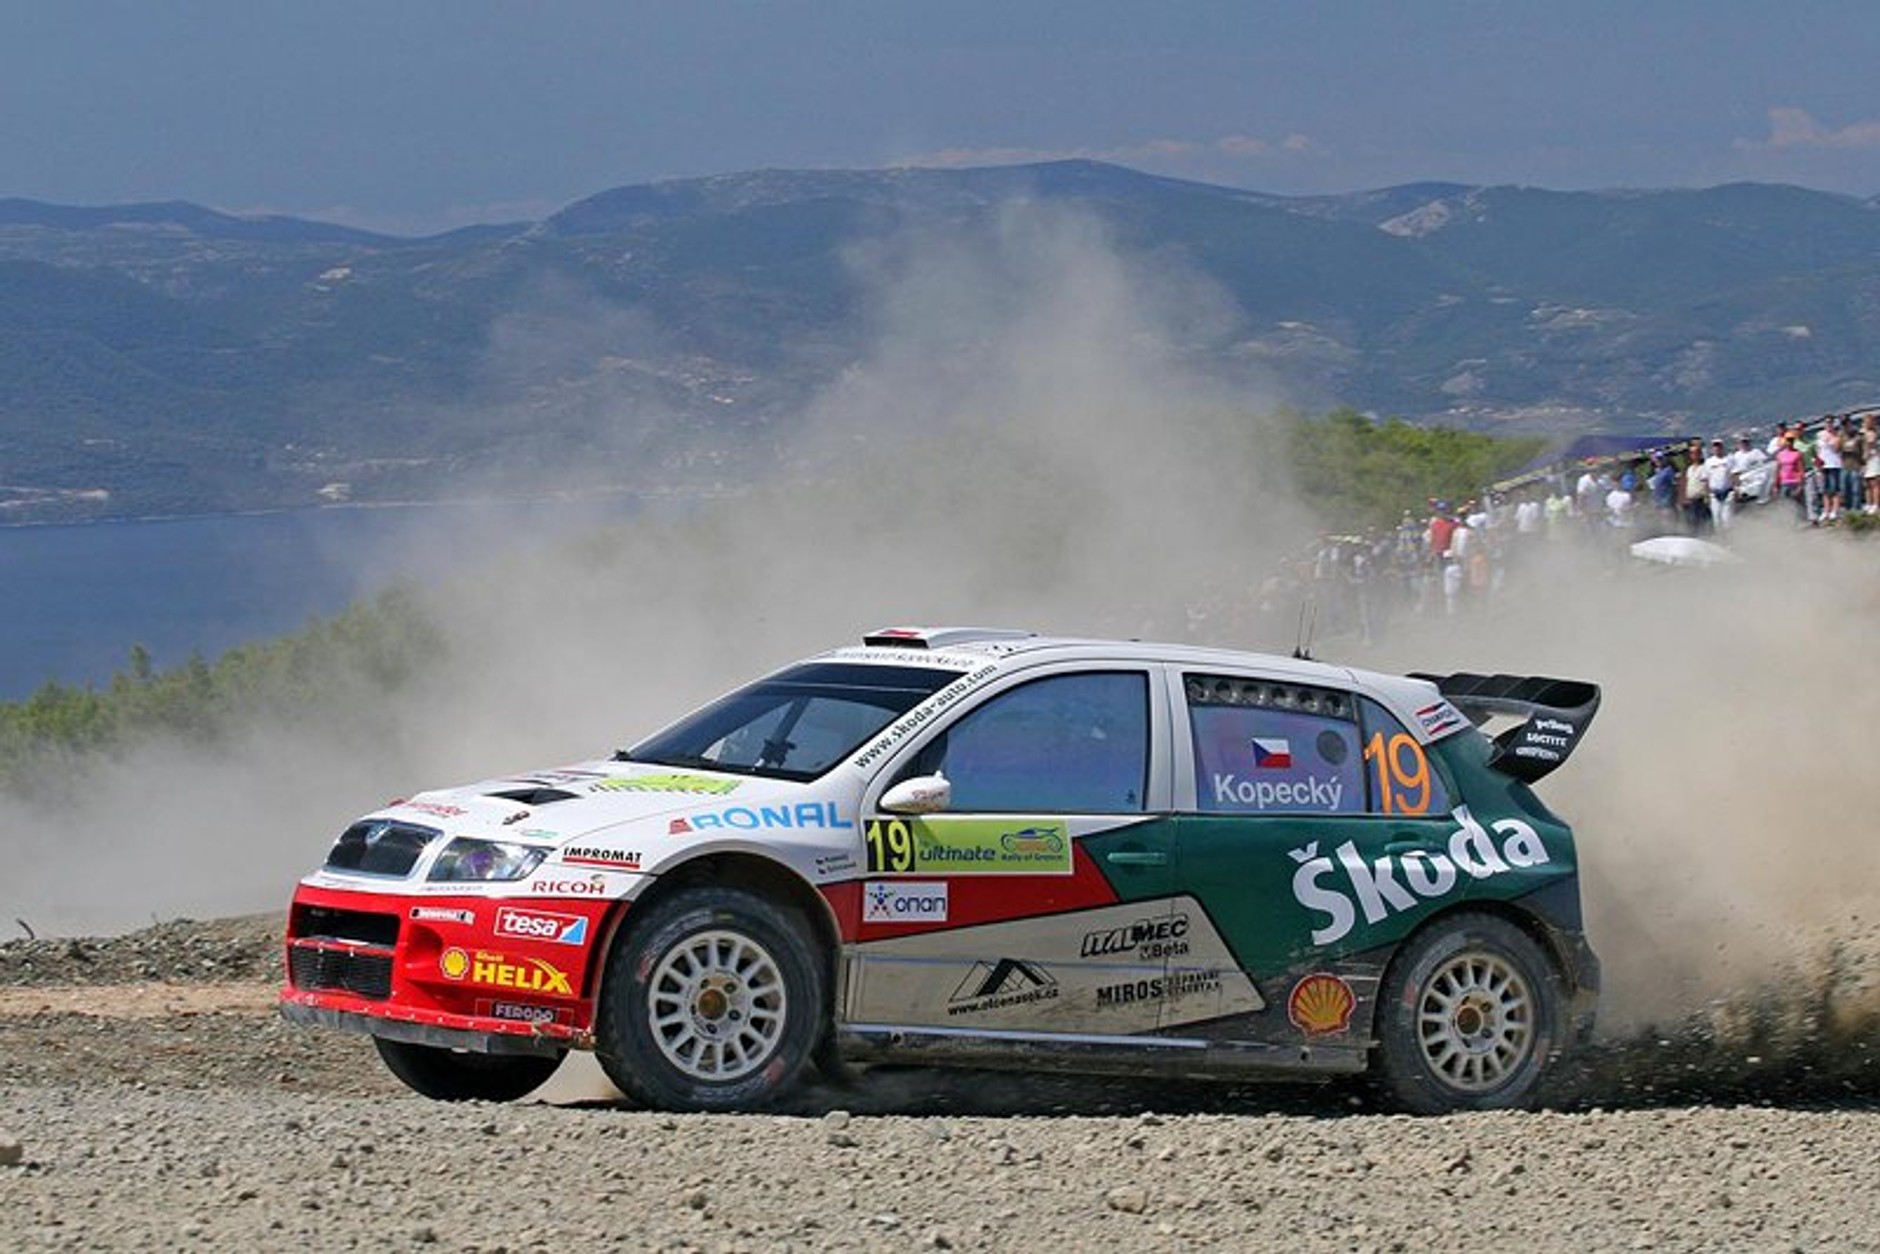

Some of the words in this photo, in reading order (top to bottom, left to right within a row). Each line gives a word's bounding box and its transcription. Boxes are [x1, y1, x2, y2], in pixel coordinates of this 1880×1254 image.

[854, 663, 997, 769] www.skoda-auto.com
[1364, 731, 1430, 816] 19
[1213, 773, 1343, 811] Kopecký
[691, 801, 853, 830] RONAL
[564, 846, 642, 863] IMPROMAT
[867, 820, 912, 873] 19
[919, 845, 996, 862] ultimate
[531, 880, 605, 894] RICOH
[1288, 804, 1550, 946] Škoda
[503, 911, 558, 936] tesa
[472, 957, 573, 994] HELIX
[1097, 979, 1162, 1005] MIROS
[495, 1003, 554, 1022] FERODO
